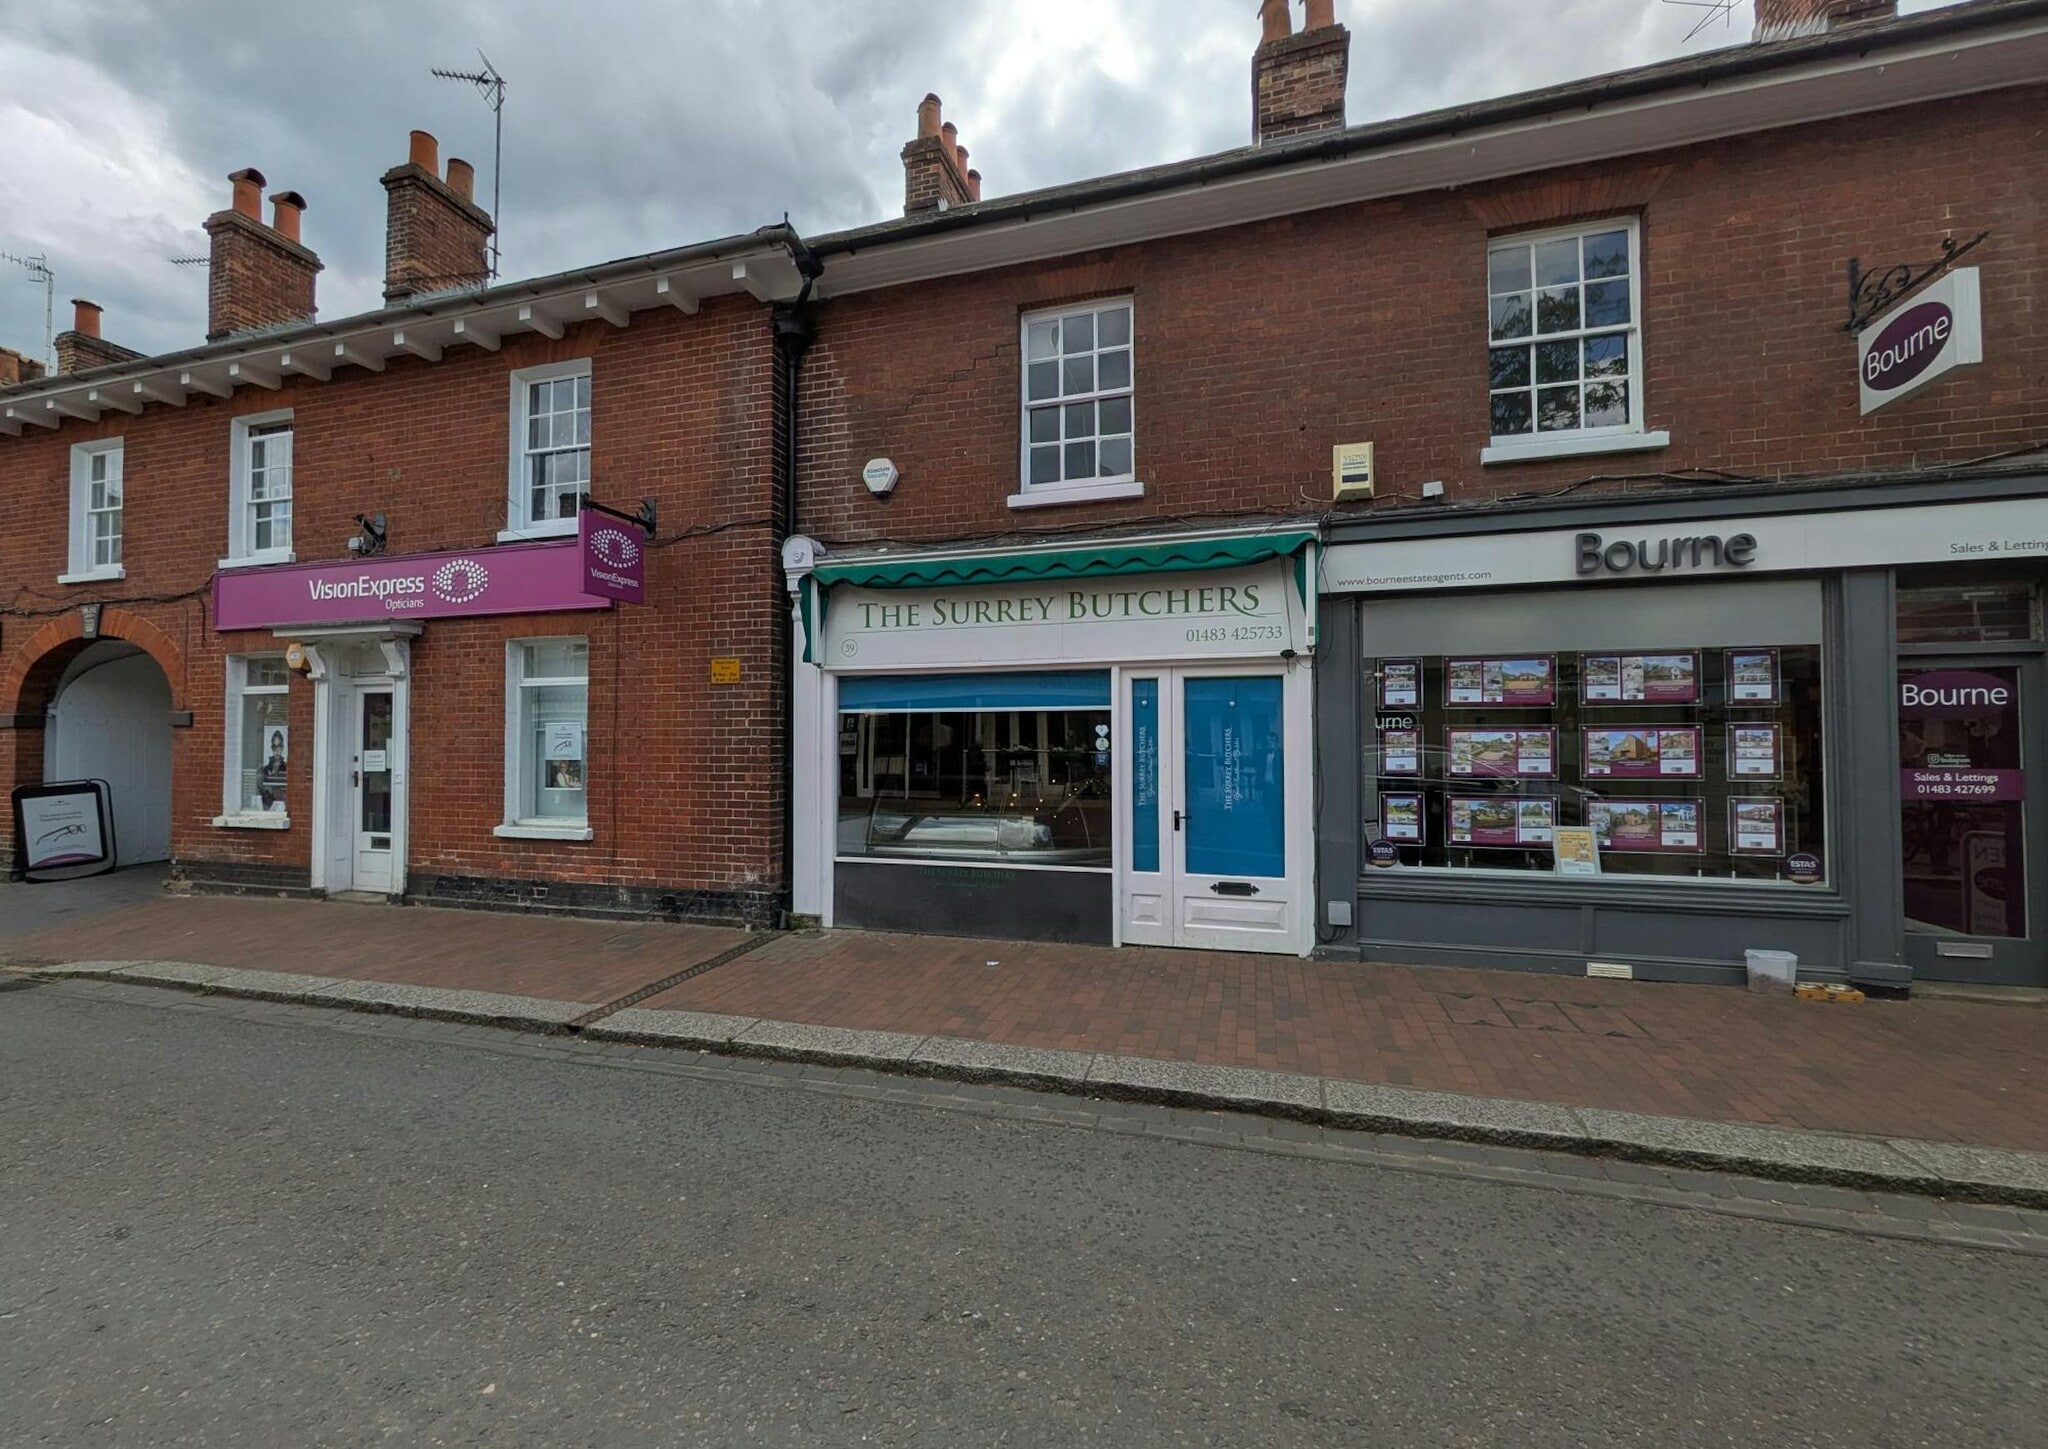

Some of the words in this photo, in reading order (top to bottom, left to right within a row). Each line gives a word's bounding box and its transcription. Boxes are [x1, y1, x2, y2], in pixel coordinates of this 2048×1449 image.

[1867, 315, 1949, 381] Bourne
[1575, 531, 1758, 575] Bourne
[1950, 543, 1984, 554] Sales
[1988, 541, 1999, 551] &
[1336, 571, 1492, 586] www.bourneestateagents.com
[309, 576, 425, 600] VisionExpress
[385, 599, 425, 611] Opticians
[858, 602, 920, 629] THE
[932, 597, 1054, 626] SURREY
[1067, 584, 1267, 619] BUTCHERS
[1186, 627, 1227, 642] 01483
[1231, 625, 1283, 640] 425733
[1902, 683, 2009, 706] Bourne
[1375, 717, 1413, 730] urne
[1914, 773, 1941, 782] Sales
[1943, 773, 1952, 782] &
[1955, 773, 1999, 785] Lettings
[1918, 785, 1951, 794] 01483
[1954, 785, 1996, 794] 427699
